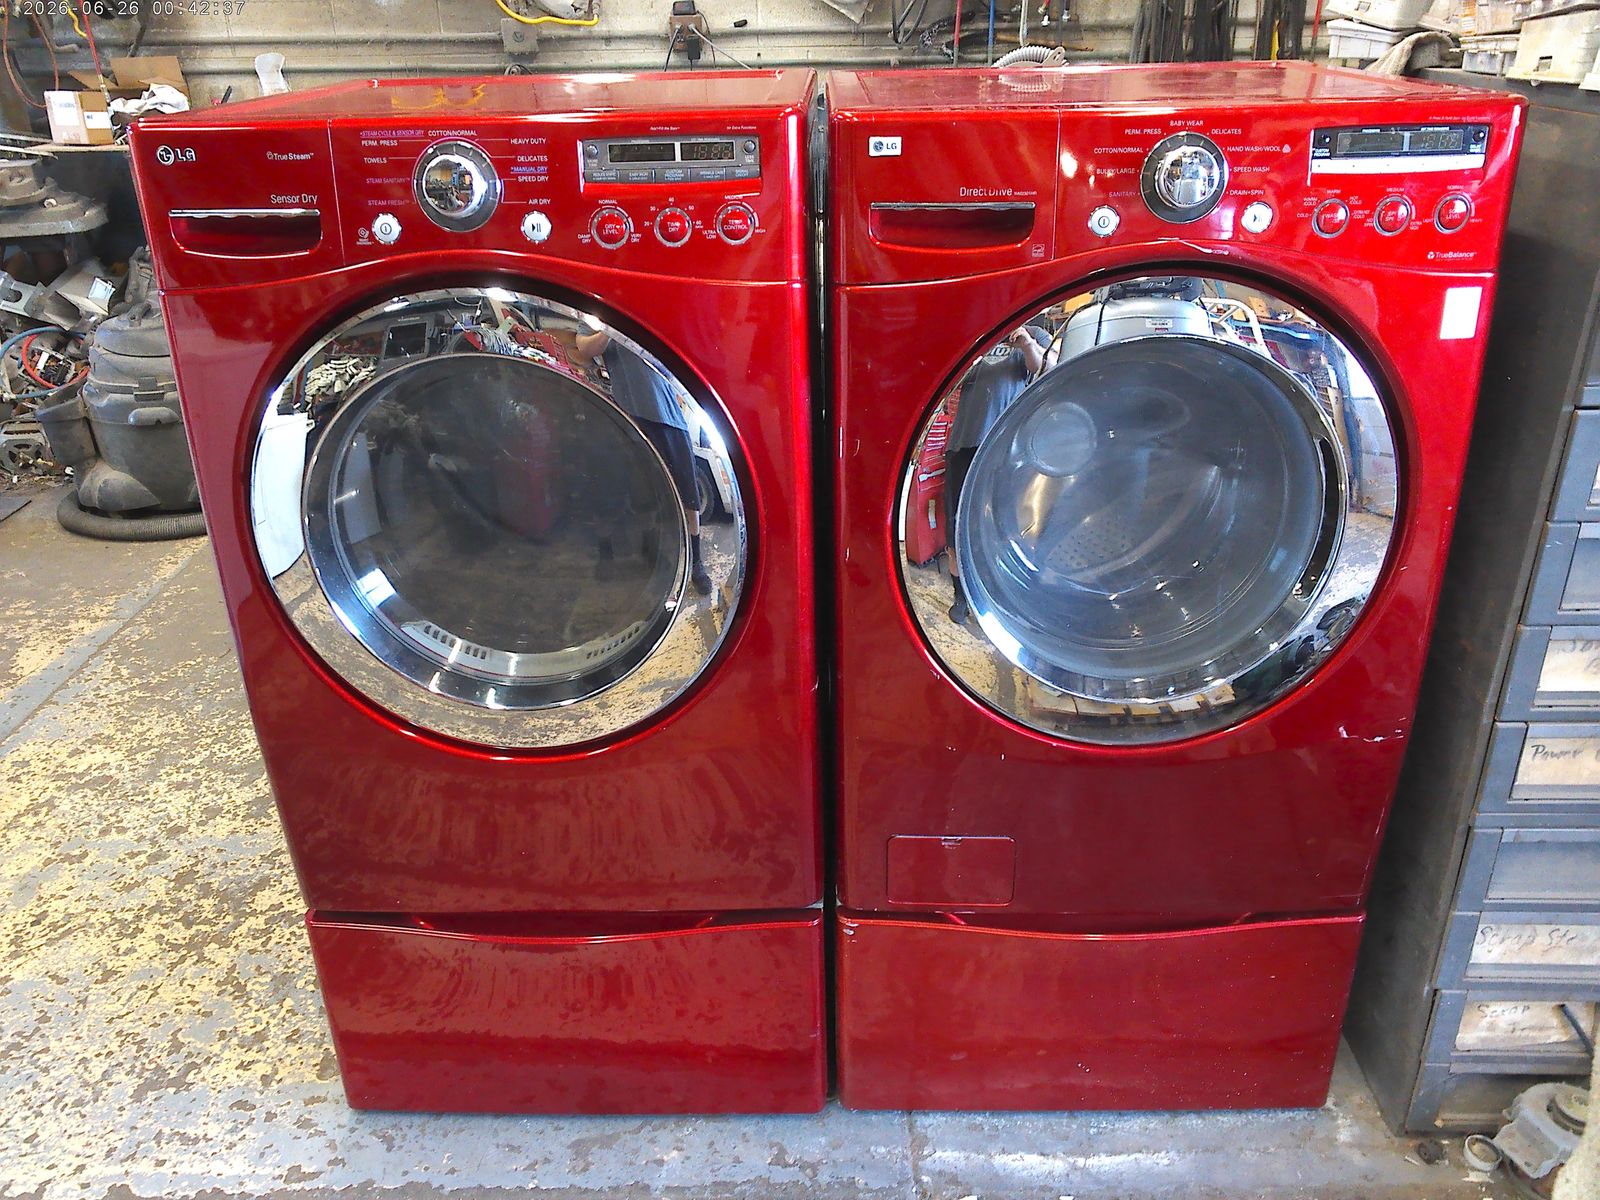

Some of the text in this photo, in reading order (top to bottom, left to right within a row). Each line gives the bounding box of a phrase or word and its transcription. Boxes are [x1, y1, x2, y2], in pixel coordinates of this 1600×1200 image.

[175, 148, 196, 162] LG
[270, 194, 318, 204] Sensor Dry
